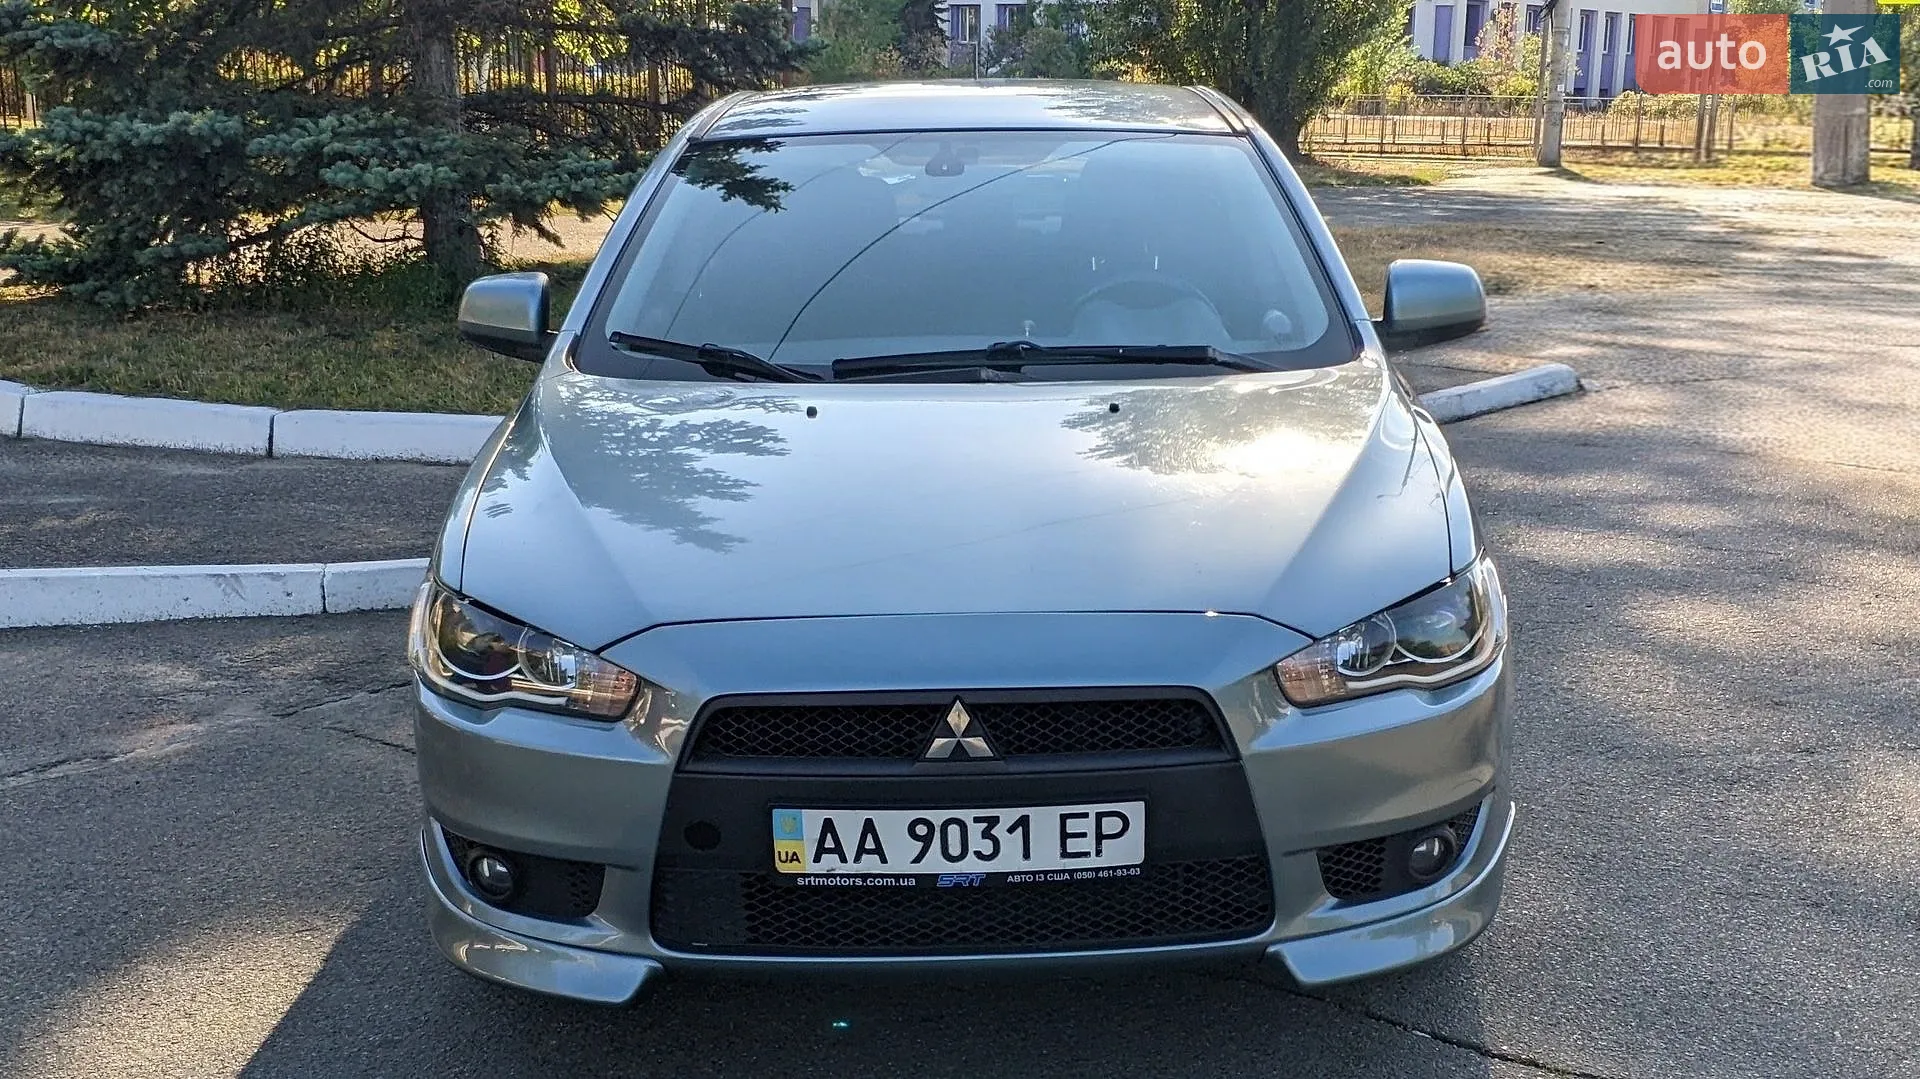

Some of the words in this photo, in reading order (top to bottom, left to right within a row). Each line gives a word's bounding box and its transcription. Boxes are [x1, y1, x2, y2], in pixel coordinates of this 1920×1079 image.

[907, 815, 1032, 864] 9031
[777, 851, 801, 864] UA
[797, 875, 916, 887] srtmotors.com.ua
[936, 874, 986, 887] SRT
[1007, 873, 1034, 883] АВТО
[1047, 872, 1070, 881] США
[1075, 870, 1096, 880] (050)
[1098, 868, 1141, 878] 461-93-03
